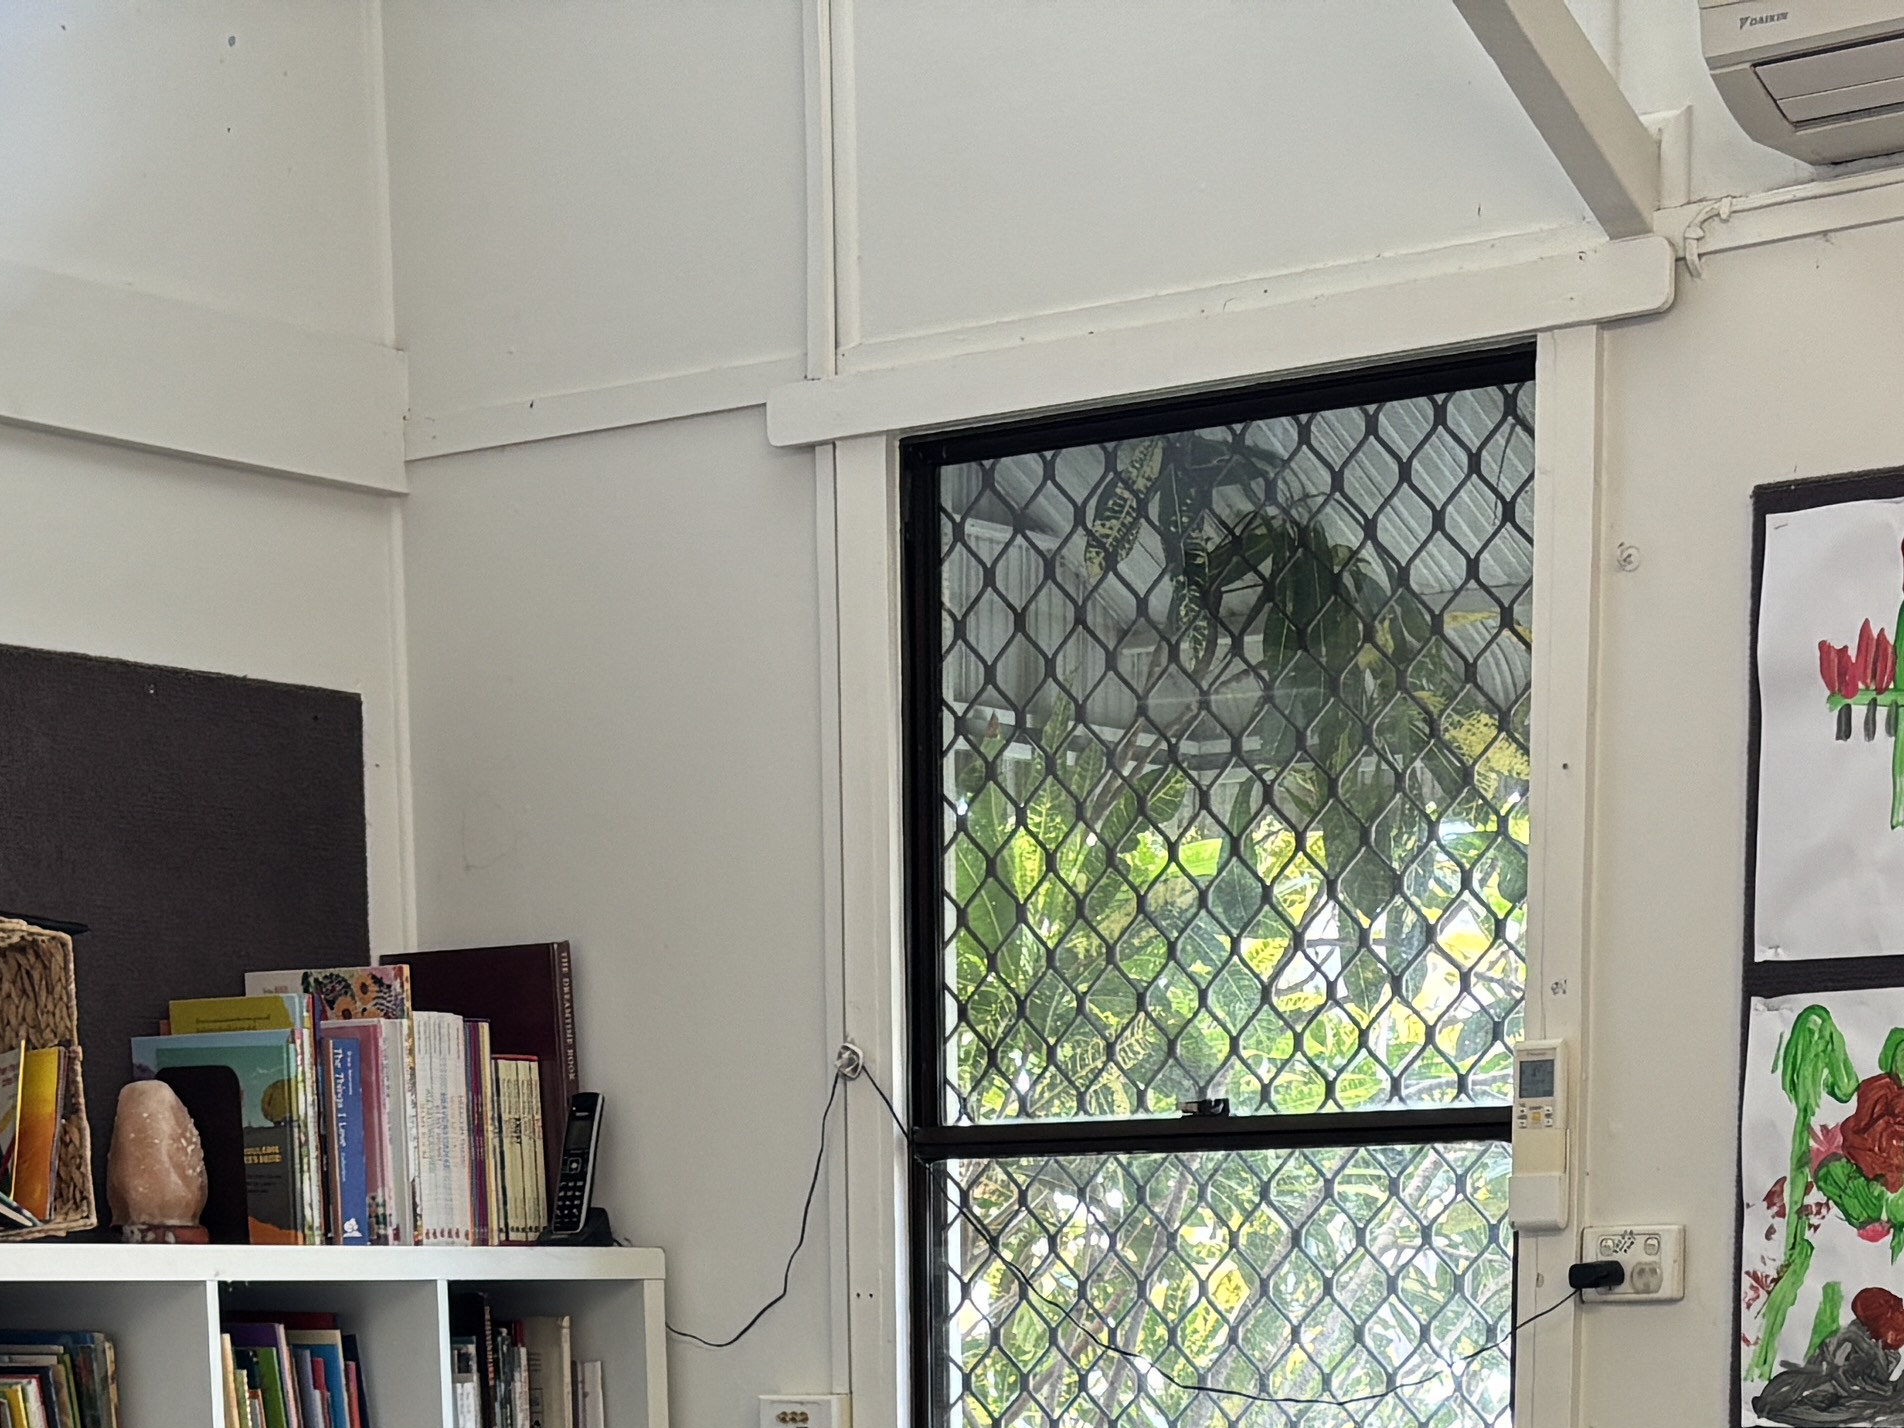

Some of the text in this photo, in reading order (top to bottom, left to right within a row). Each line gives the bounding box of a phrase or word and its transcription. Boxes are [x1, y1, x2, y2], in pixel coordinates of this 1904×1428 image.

[561, 952, 577, 1080] THE DREAMTIME BOOK
[332, 1047, 342, 1068] The
[333, 1072, 345, 1109] Things
[337, 1121, 347, 1148] Love
